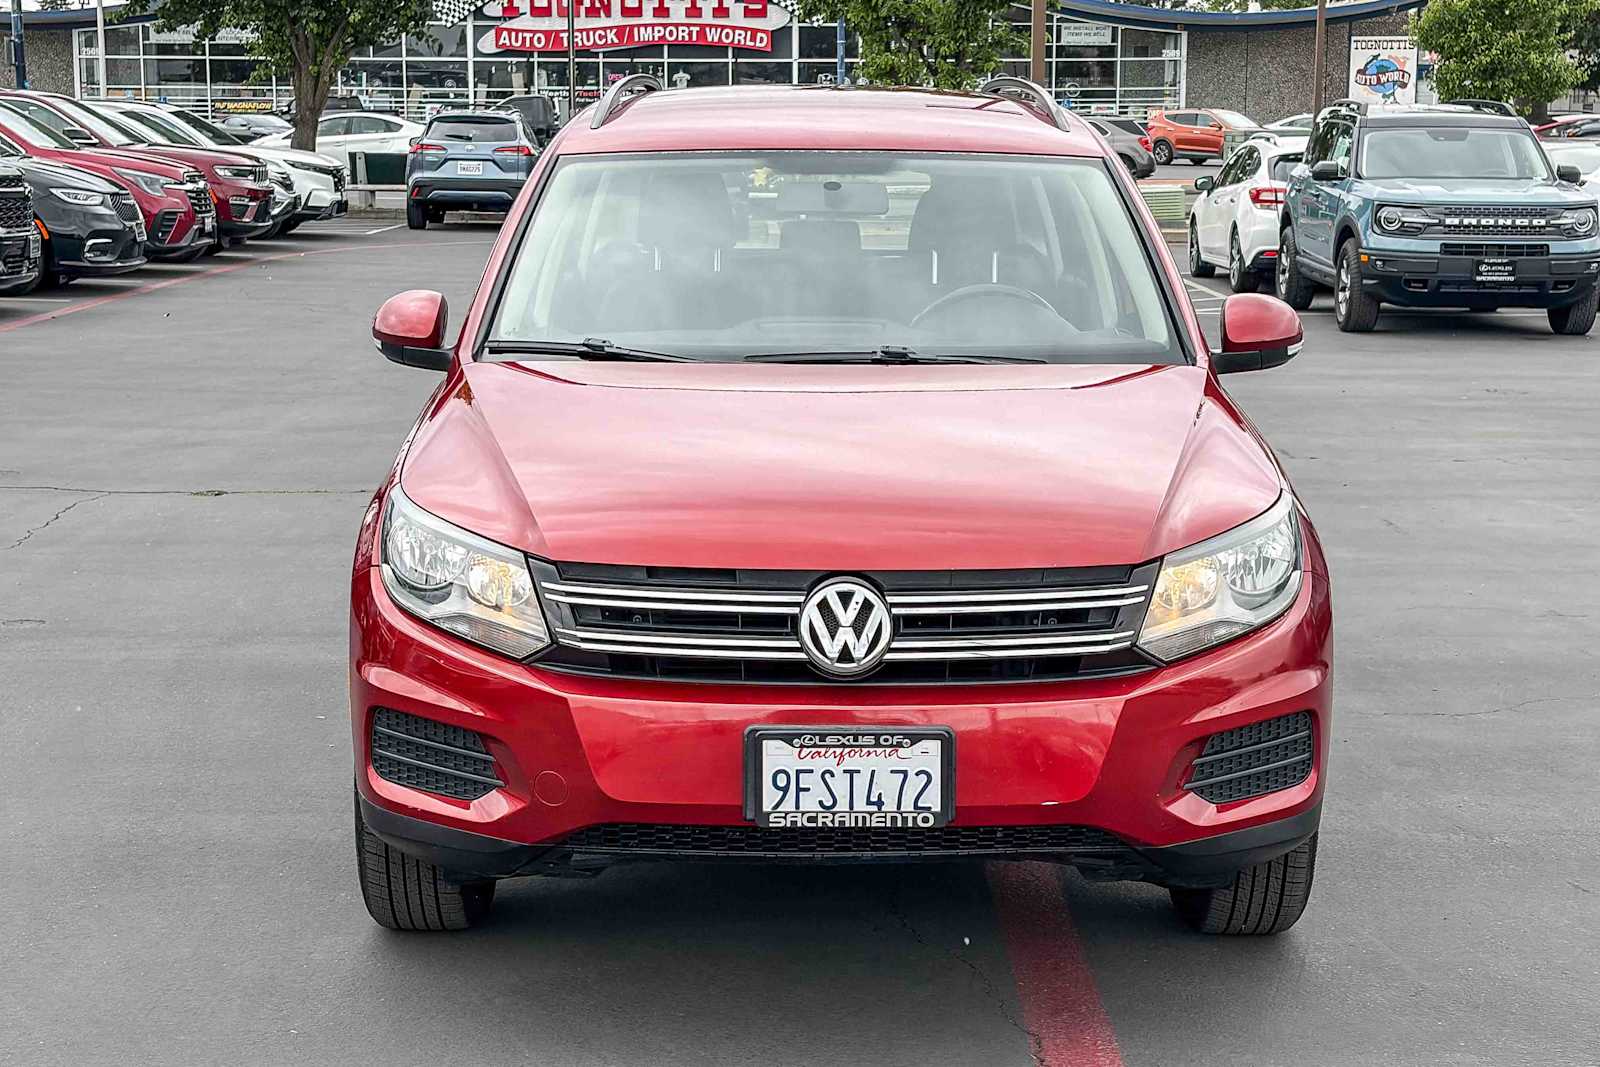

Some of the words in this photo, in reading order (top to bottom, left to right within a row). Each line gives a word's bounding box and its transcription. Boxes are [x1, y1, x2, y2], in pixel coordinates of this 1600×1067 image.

[498, 30, 546, 47] AUTO
[560, 28, 619, 47] TRUCK
[634, 26, 700, 42] IMPORT
[705, 27, 768, 48] WORLD
[1356, 74, 1378, 85] AUTO
[1379, 70, 1410, 83] WORLD
[1445, 218, 1546, 226] BRONCO
[814, 736, 876, 746] LEXUS
[879, 736, 904, 746] OF
[796, 746, 912, 768] California
[771, 768, 933, 812] 9FST472
[768, 812, 935, 828] SACRAMENTO
